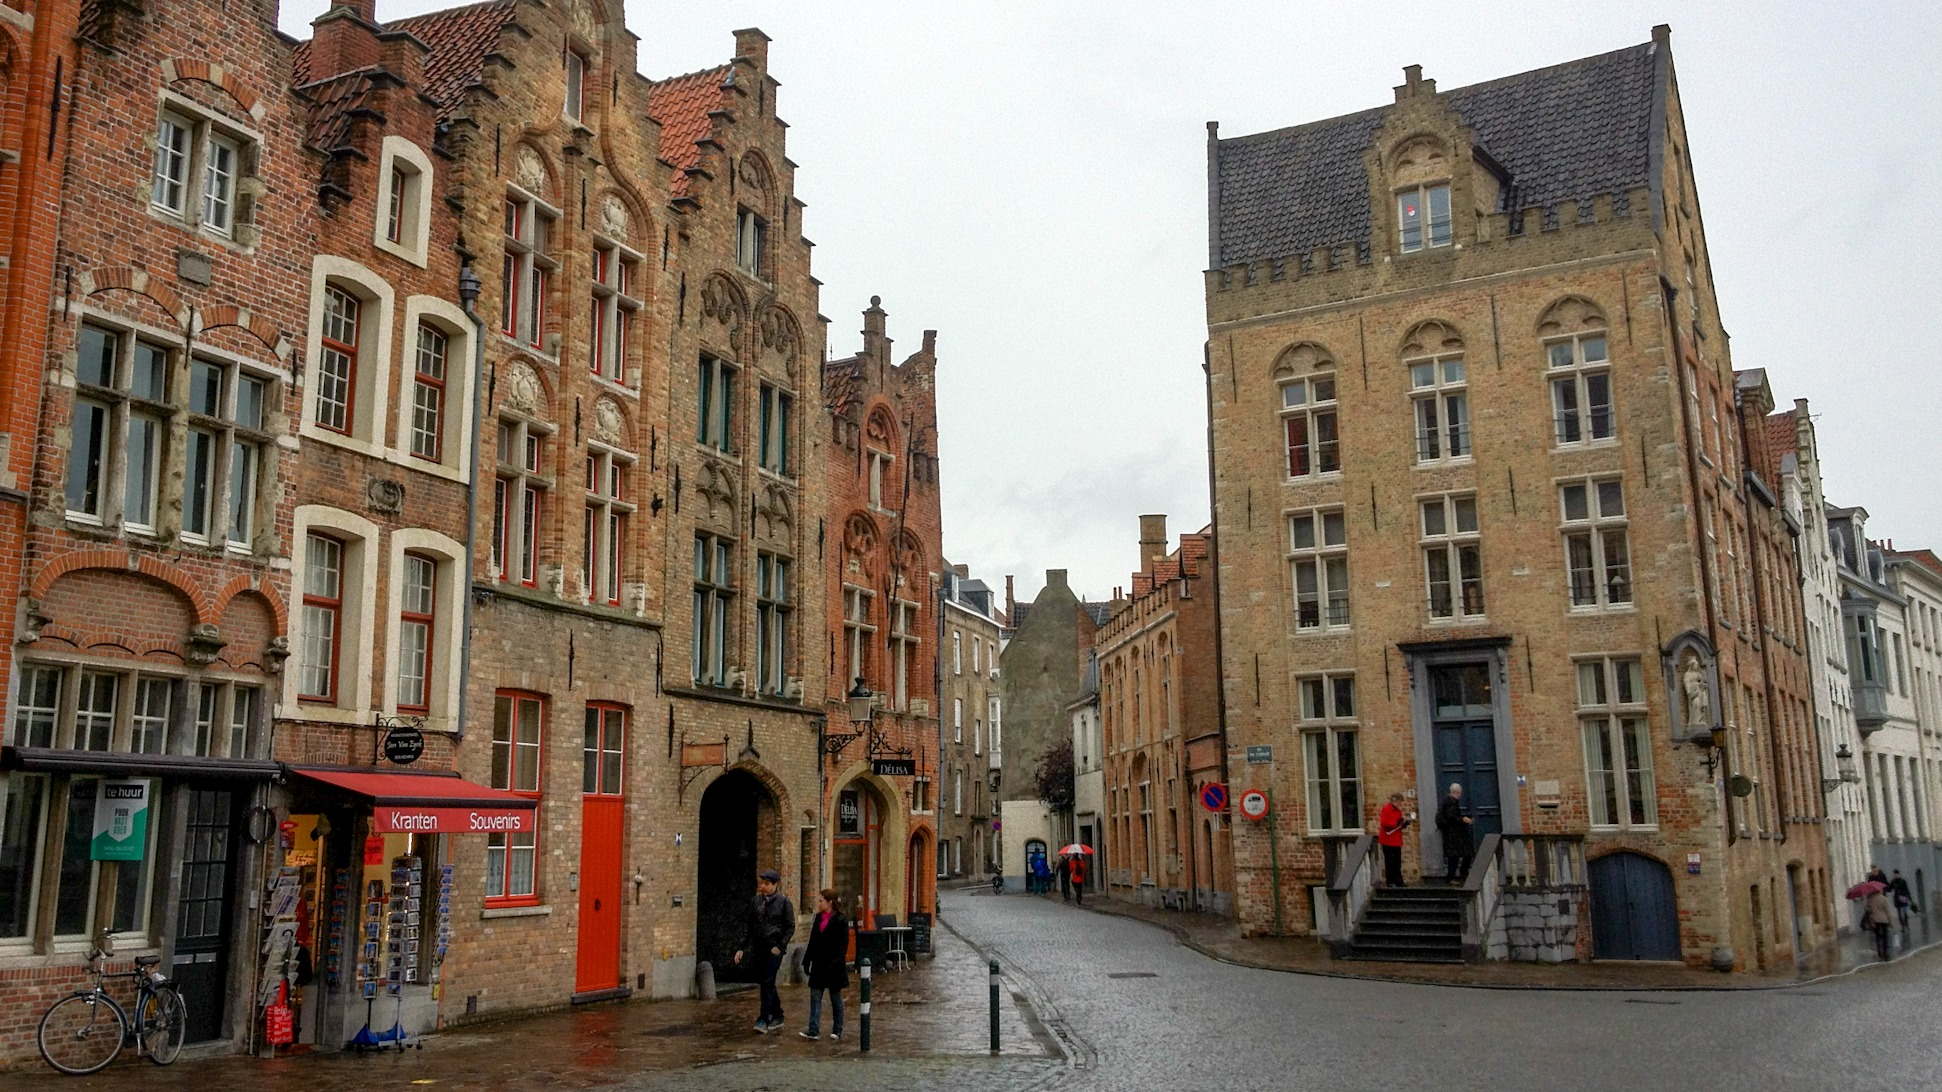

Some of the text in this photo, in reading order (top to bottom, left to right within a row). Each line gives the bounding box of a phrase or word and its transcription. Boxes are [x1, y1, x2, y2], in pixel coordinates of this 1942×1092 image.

[107, 787, 142, 798] te huur
[391, 811, 520, 829] Kranten Souvenirs
